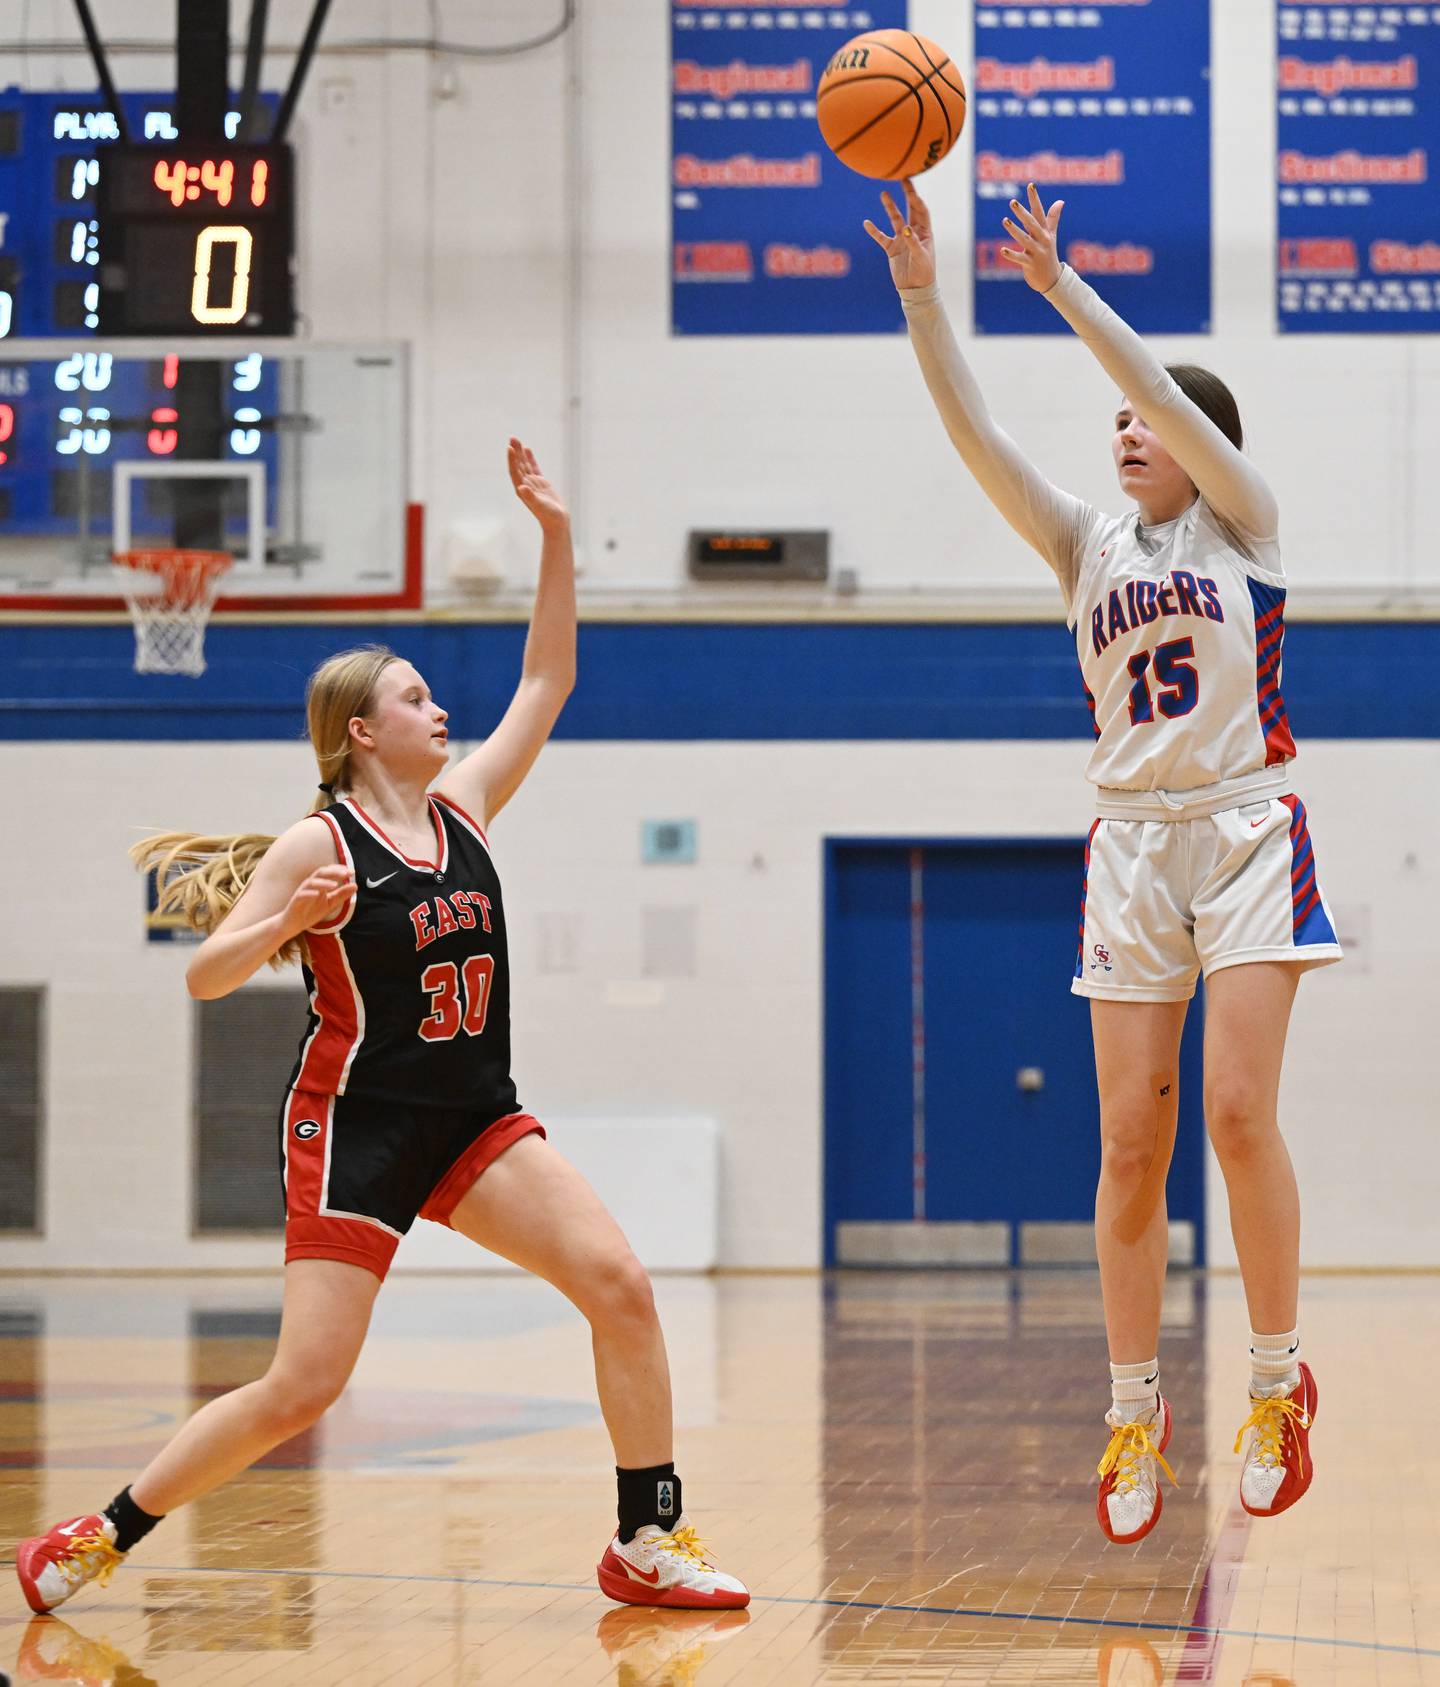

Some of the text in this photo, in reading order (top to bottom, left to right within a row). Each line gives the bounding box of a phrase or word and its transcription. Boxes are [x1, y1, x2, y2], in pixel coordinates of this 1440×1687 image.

[154, 159, 268, 207] 4:41
[191, 226, 252, 324] 0
[1092, 570, 1224, 658] RAIDERS
[1127, 636, 1199, 726] 15
[408, 890, 492, 952] EAST
[417, 953, 495, 1043] 30
